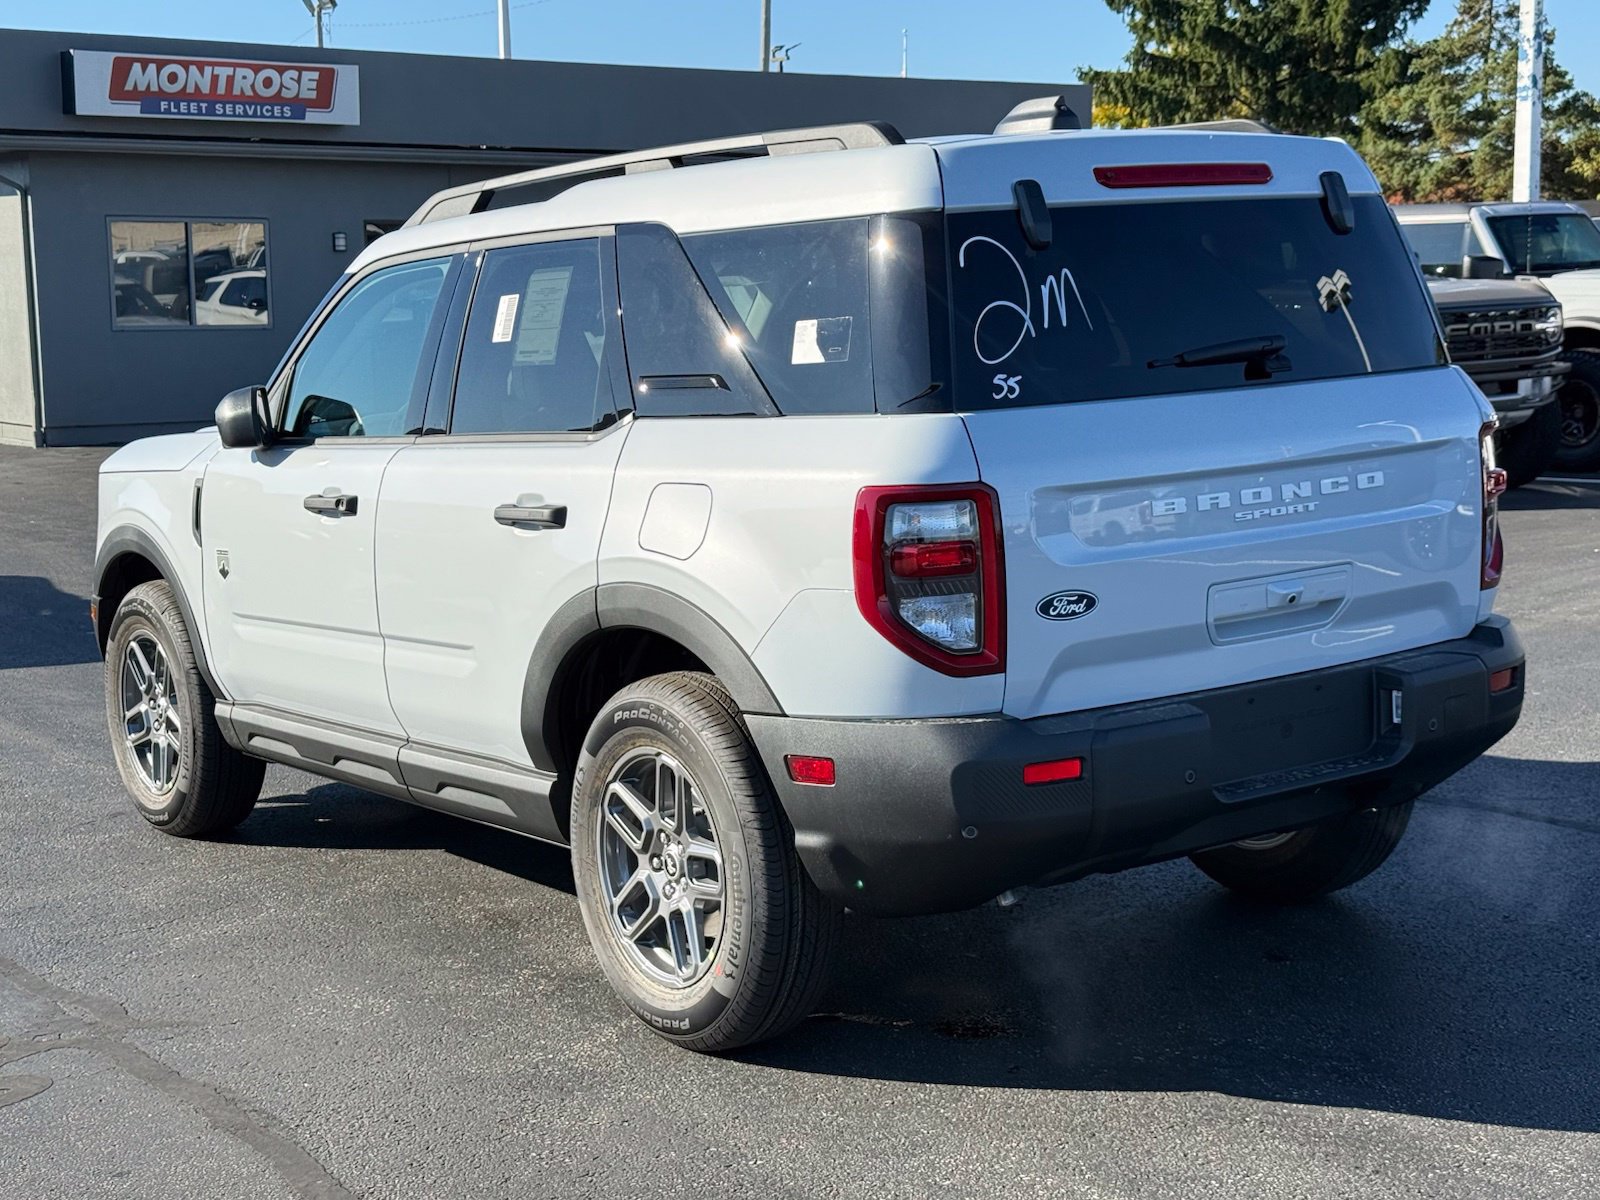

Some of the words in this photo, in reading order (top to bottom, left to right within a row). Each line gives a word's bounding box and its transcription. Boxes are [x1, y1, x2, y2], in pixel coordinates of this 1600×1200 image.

[123, 62, 321, 99] MONTROSE
[160, 101, 208, 114] FLEET
[215, 103, 292, 117] SERVICES
[1152, 471, 1384, 517] BRONCO
[1234, 501, 1319, 522] SPORT
[1049, 595, 1087, 615] Ford
